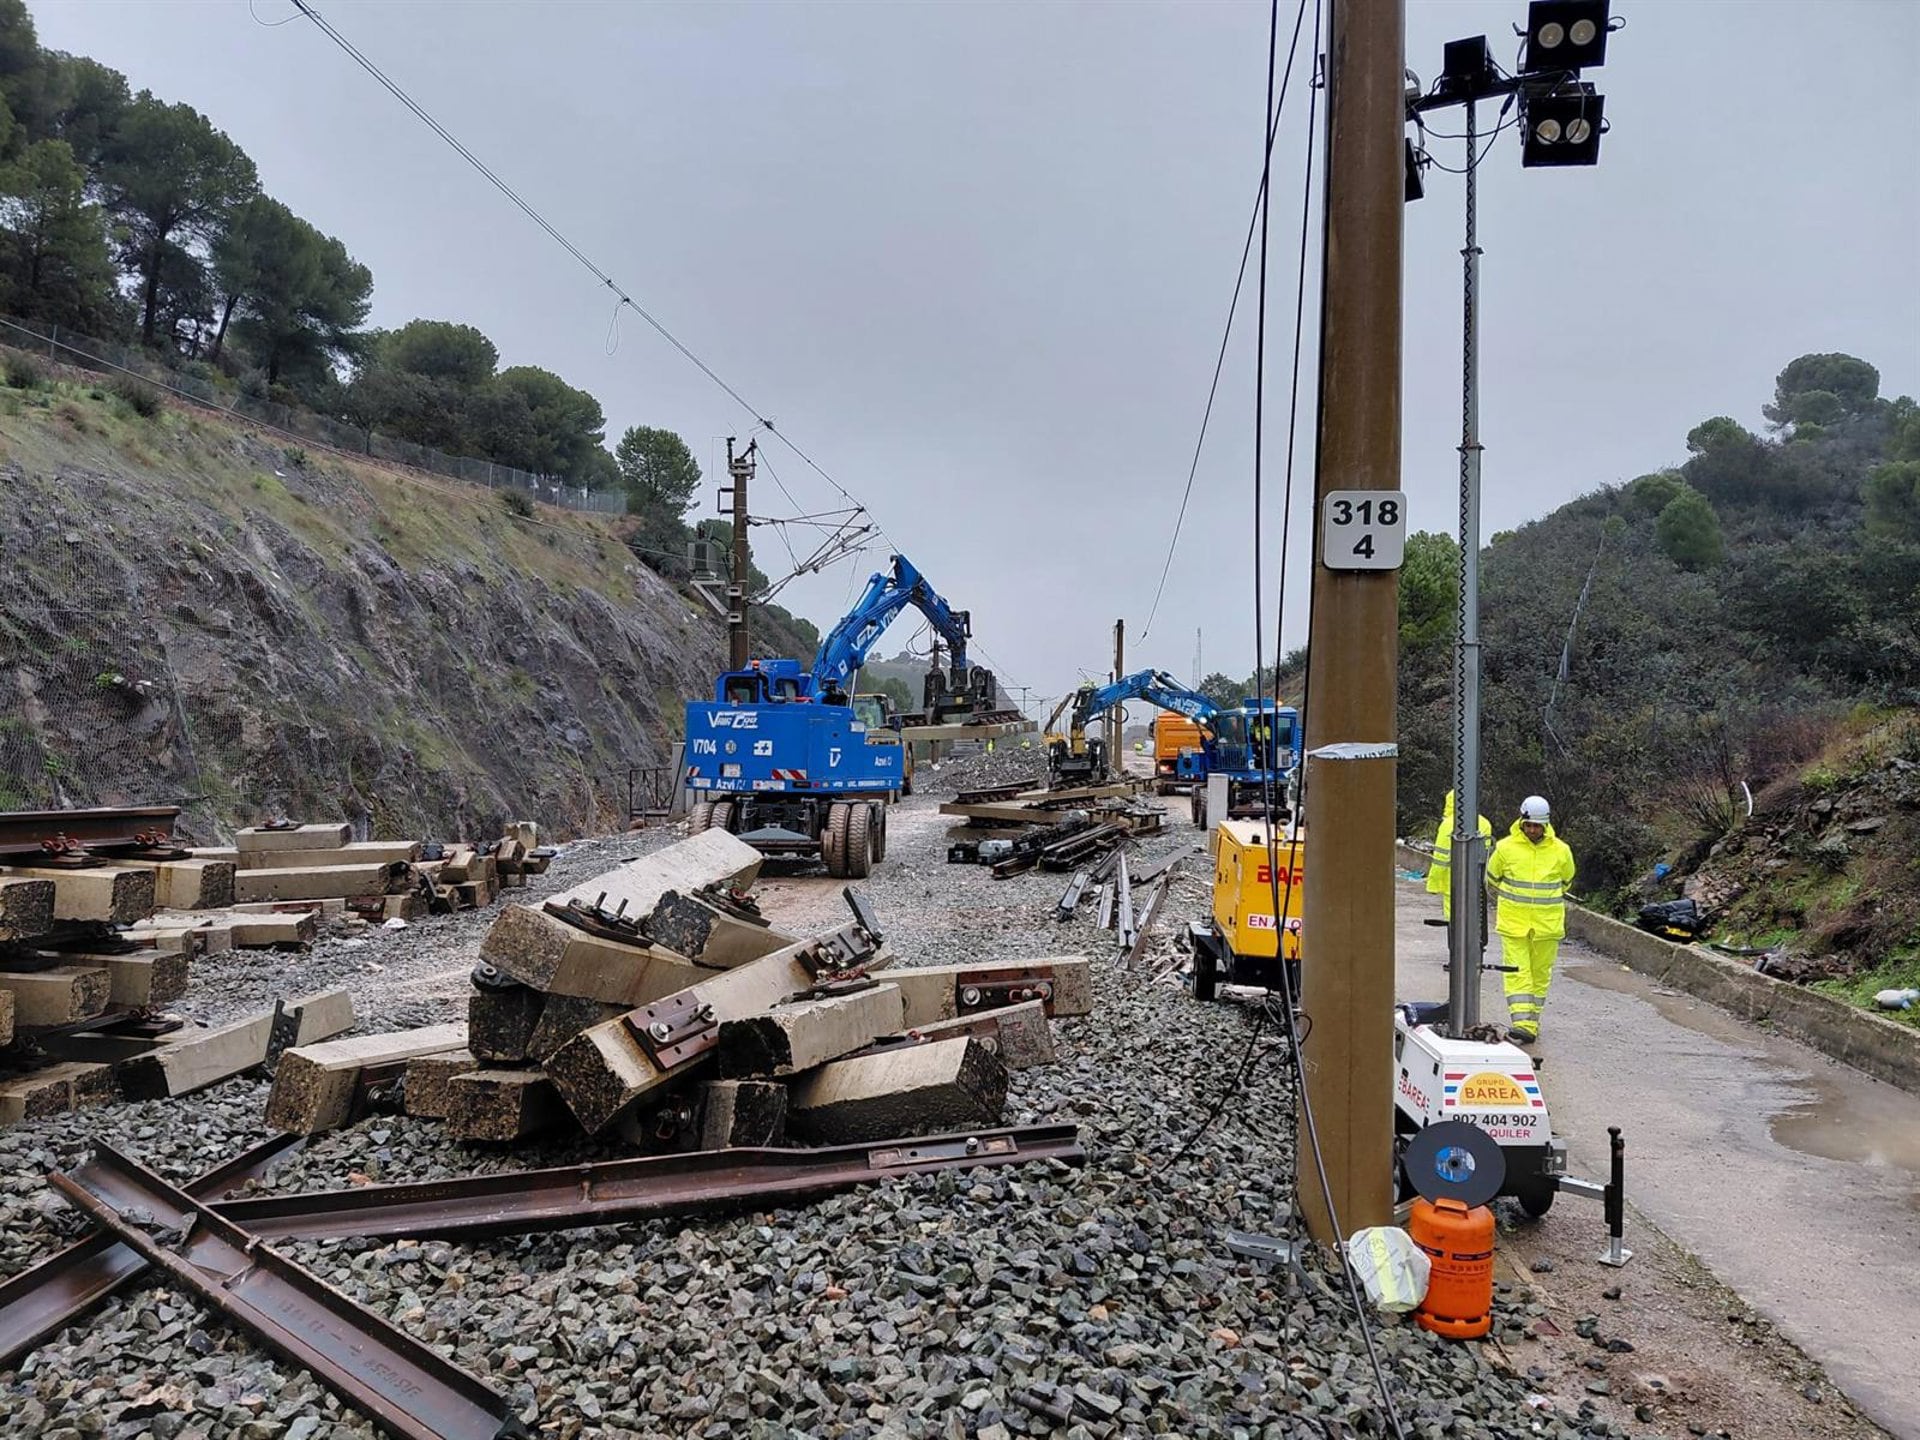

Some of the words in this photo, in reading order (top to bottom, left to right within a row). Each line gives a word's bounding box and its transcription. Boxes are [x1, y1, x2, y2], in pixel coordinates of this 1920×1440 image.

[1332, 500, 1399, 526] 318
[1353, 534, 1375, 559] 4
[693, 739, 717, 755] V704
[716, 778, 735, 790] Azvi
[1257, 865, 1304, 886] BAR
[1249, 916, 1268, 927] EN
[1401, 1077, 1427, 1111] BAREA
[1465, 1087, 1521, 1099] BAREA
[1452, 1114, 1477, 1126] 902
[1482, 1114, 1507, 1126] 404
[1512, 1115, 1537, 1127] 902
[1489, 1128, 1531, 1138] QUILER
